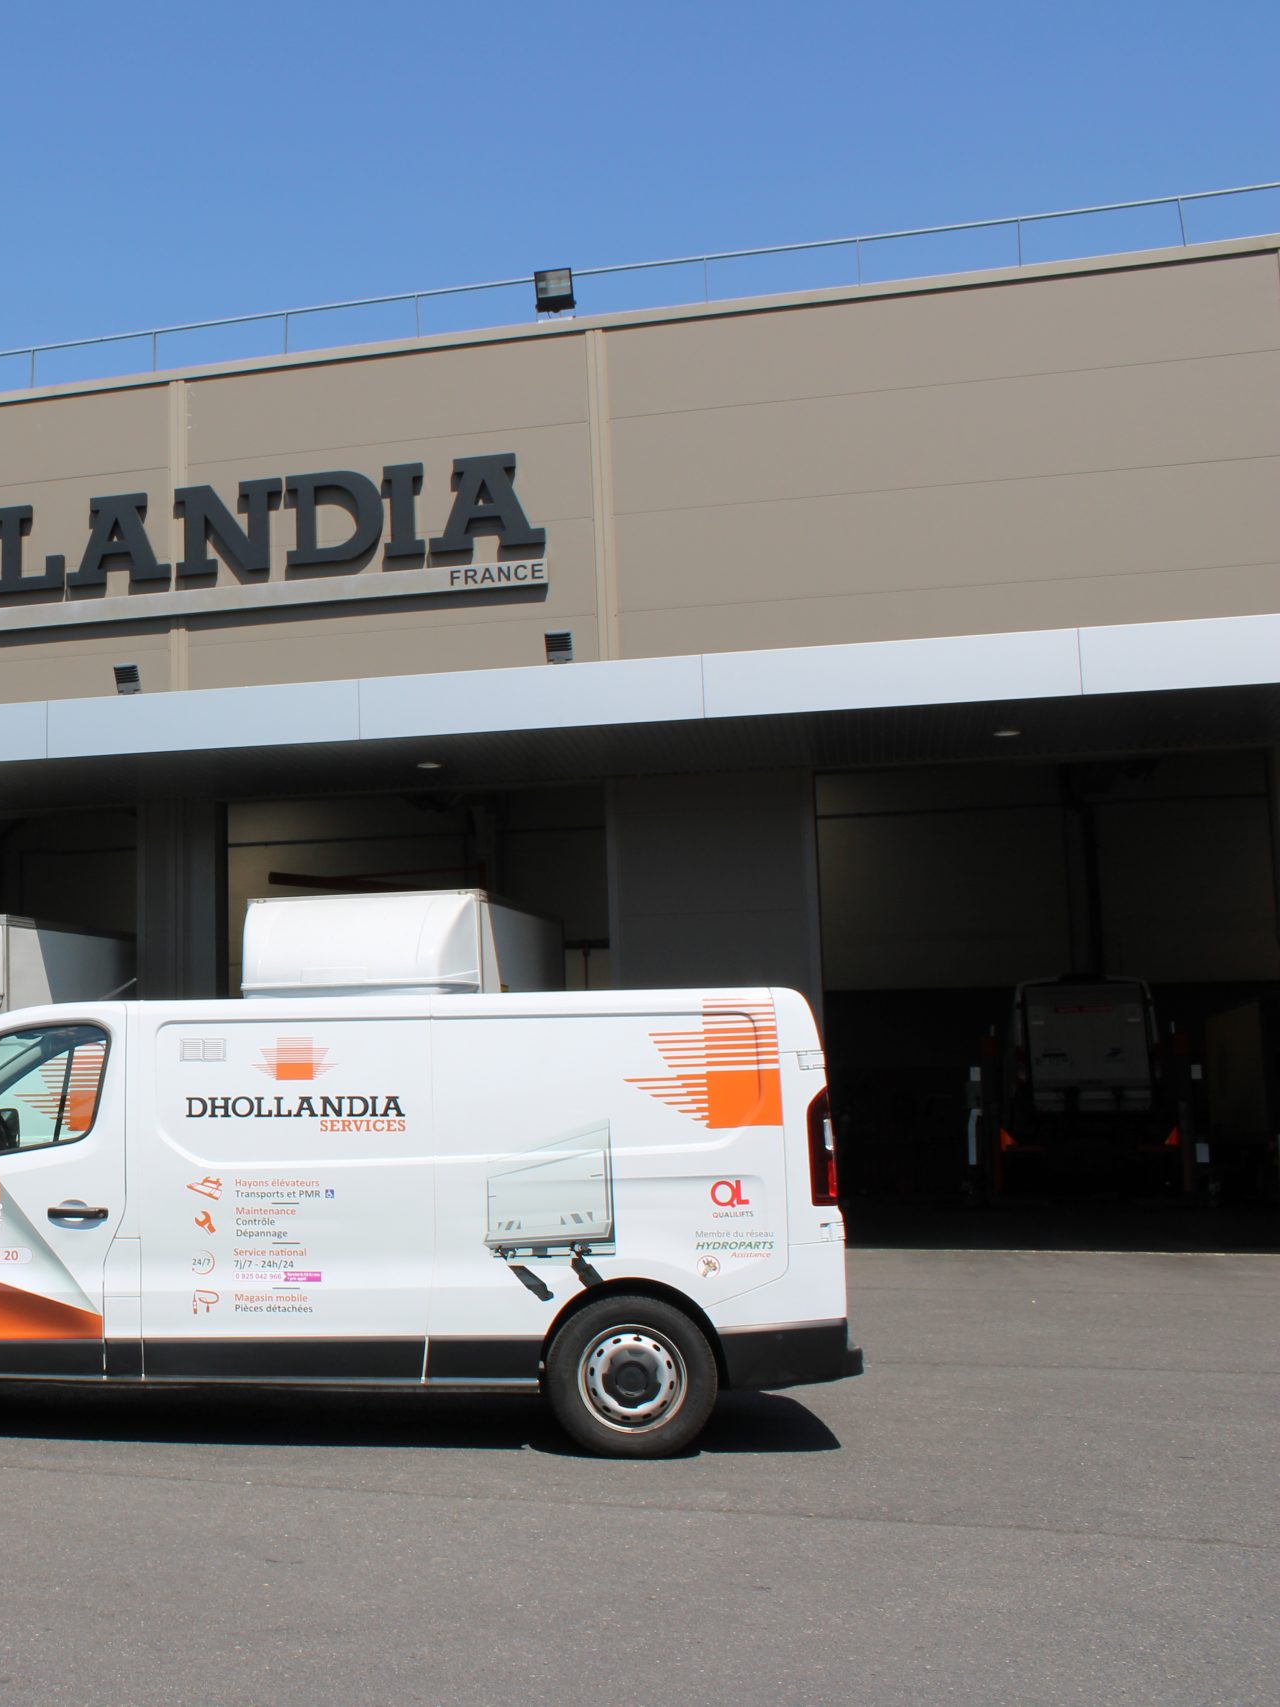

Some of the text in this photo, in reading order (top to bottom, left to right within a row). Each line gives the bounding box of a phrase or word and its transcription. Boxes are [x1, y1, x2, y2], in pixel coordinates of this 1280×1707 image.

[449, 563, 544, 586] FRANCE
[185, 1096, 406, 1118] DHOLLANDIA
[320, 1119, 406, 1132] SERVICES
[235, 1178, 320, 1189] Hayons élévateurs
[235, 1190, 321, 1199] Transports et PMR
[710, 1179, 750, 1208] QL
[235, 1207, 297, 1215] Maintenance
[235, 1217, 276, 1226] Contrôle
[236, 1229, 288, 1239] Dépannage
[695, 1229, 774, 1238] Membre du réseau
[695, 1241, 775, 1250] HYDROPARTS
[4, 1250, 19, 1261] 20
[233, 1247, 307, 1257] Service national
[192, 1258, 211, 1267] 24/7
[234, 1260, 253, 1270] 7j/7
[261, 1259, 294, 1269] 24h/24
[235, 1293, 308, 1303] Magasin mobile
[235, 1304, 313, 1313] Pièces détachées
